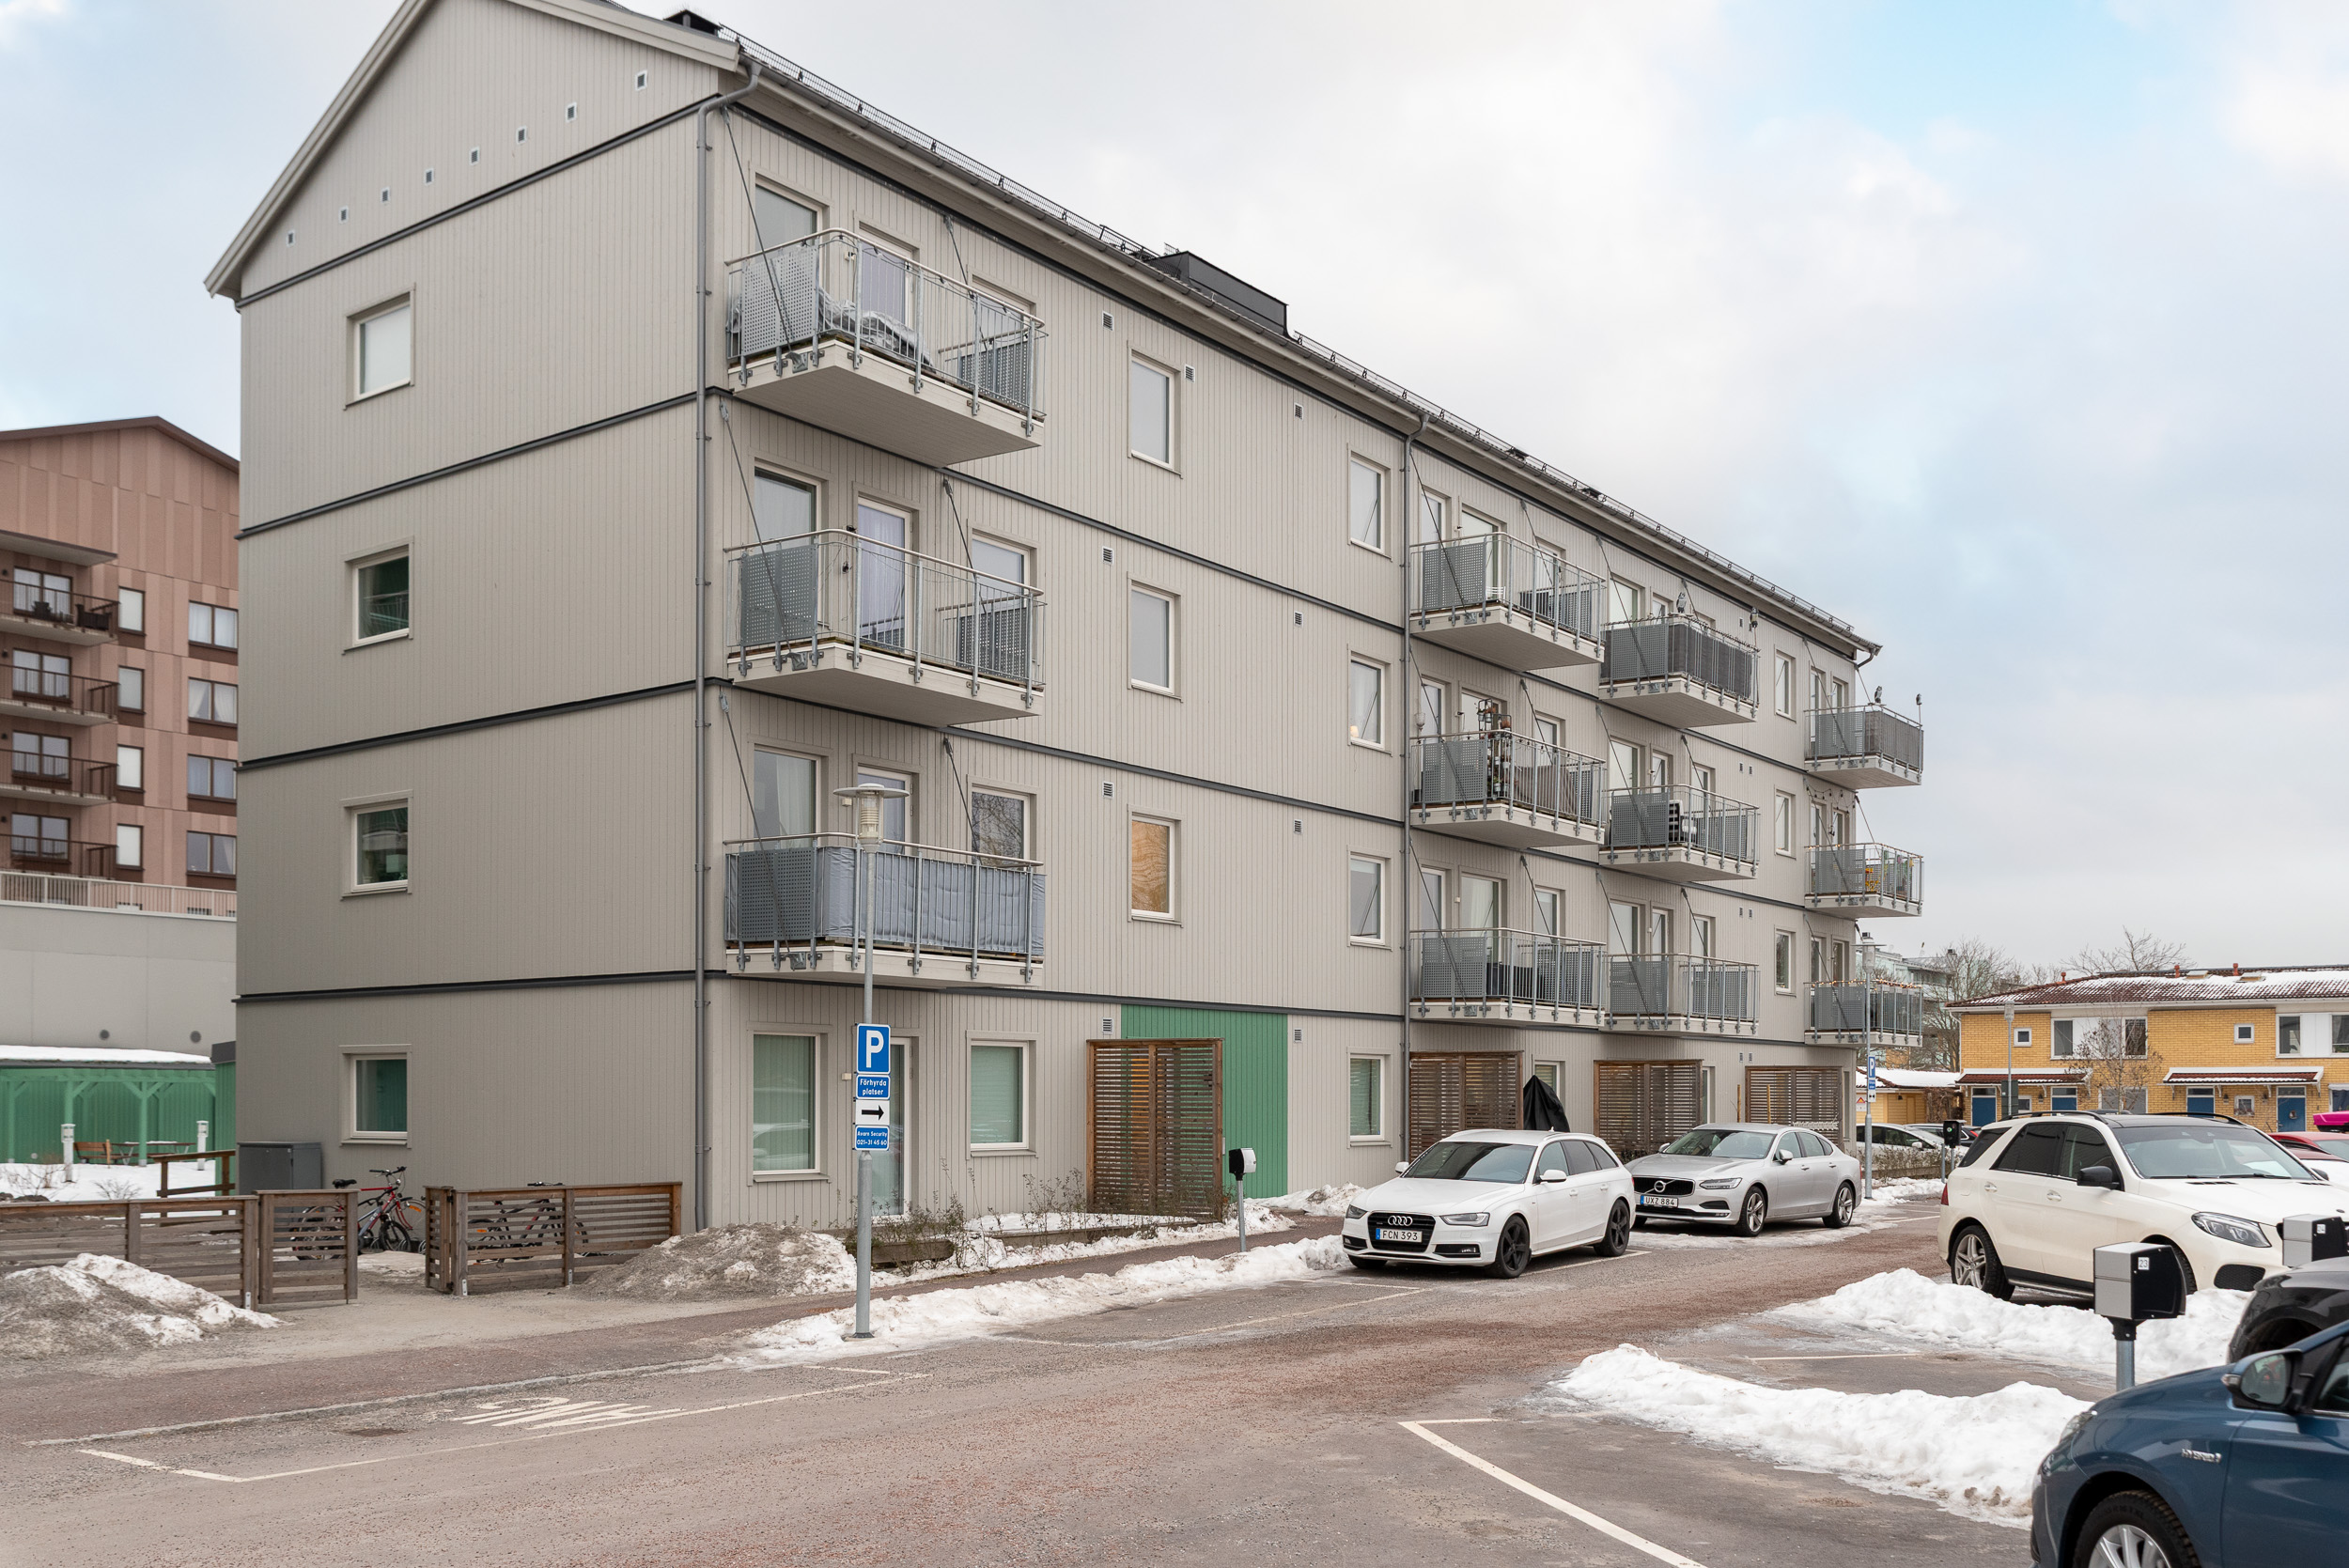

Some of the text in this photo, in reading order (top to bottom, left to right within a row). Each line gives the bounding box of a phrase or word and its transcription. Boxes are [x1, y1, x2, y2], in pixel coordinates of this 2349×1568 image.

[866, 1030, 884, 1068] P
[1870, 1058, 1875, 1077] P
[860, 1078, 887, 1088] Förhyrda
[1382, 1230, 1418, 1240] FCN 393
[2139, 1259, 2148, 1268] 23
